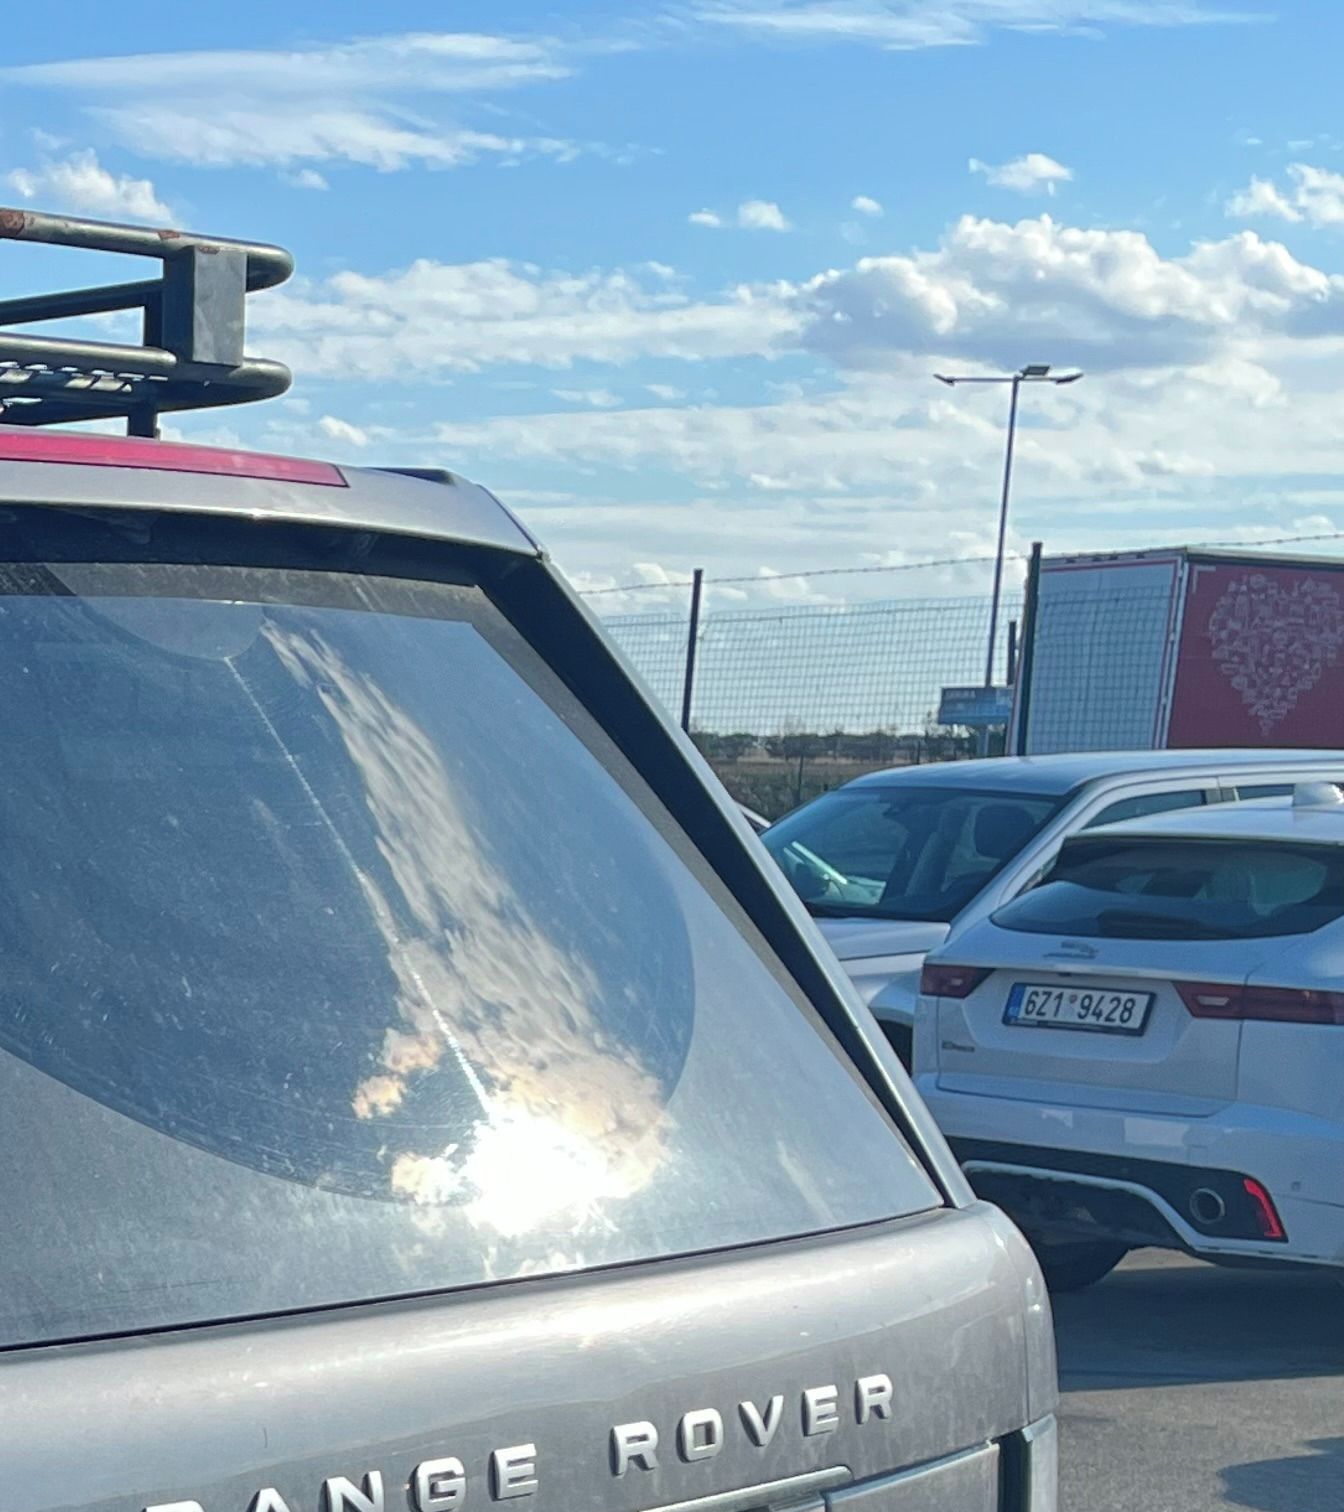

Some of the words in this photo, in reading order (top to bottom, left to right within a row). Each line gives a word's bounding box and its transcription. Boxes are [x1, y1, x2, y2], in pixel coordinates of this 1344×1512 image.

[1024, 989, 1065, 1018] 6Z1
[1076, 993, 1137, 1024] 9428
[610, 1373, 894, 1480] ROVER
